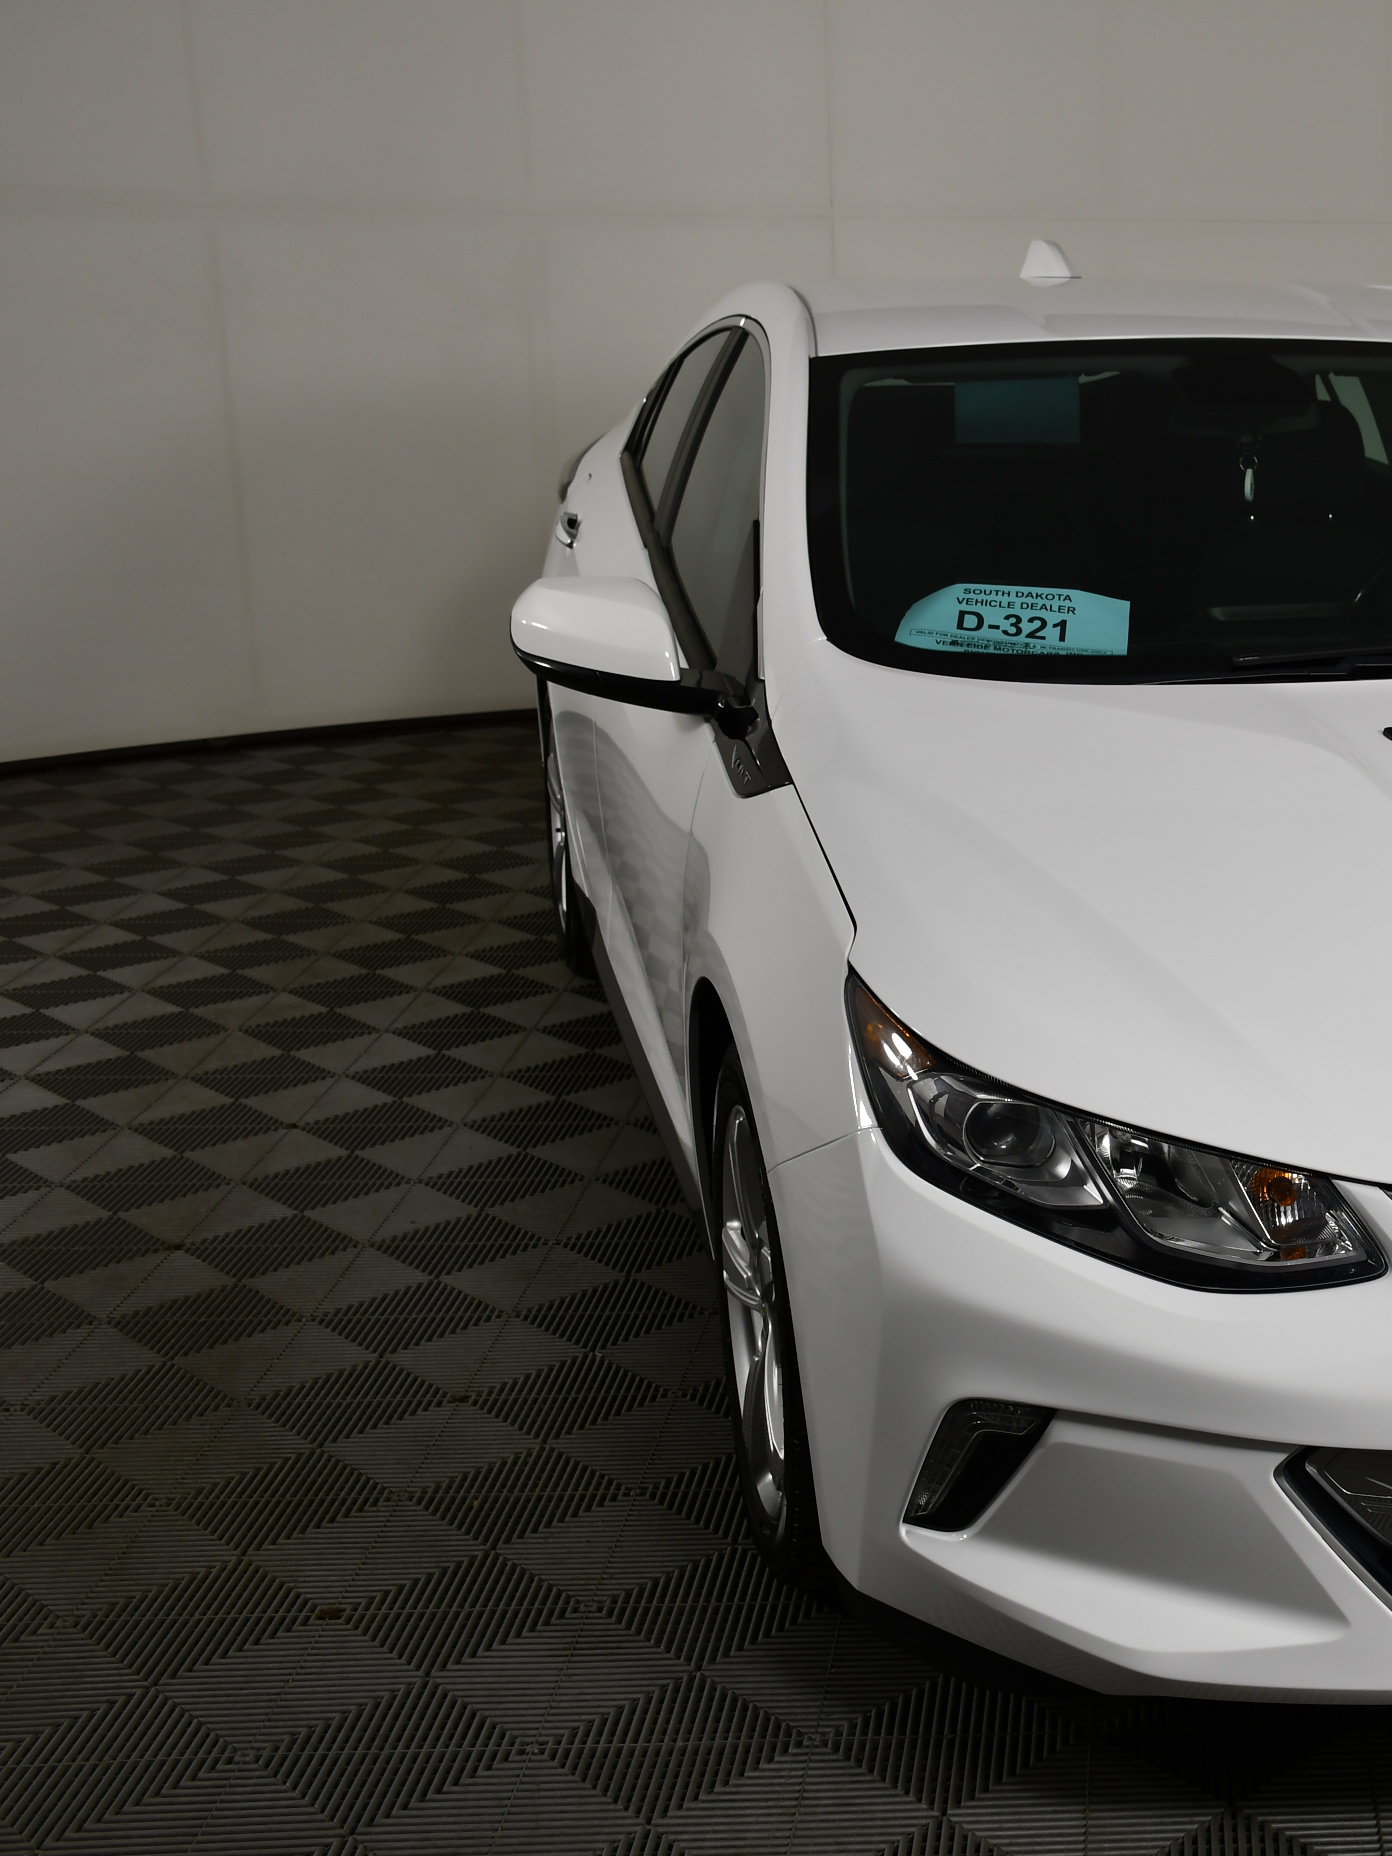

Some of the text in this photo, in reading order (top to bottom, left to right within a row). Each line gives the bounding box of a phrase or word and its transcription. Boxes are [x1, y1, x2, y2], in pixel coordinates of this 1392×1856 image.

[963, 588, 1073, 603] SOUTH DAKOTA
[956, 597, 1077, 615] VEHICLE DEALER
[956, 609, 1068, 643] D-321
